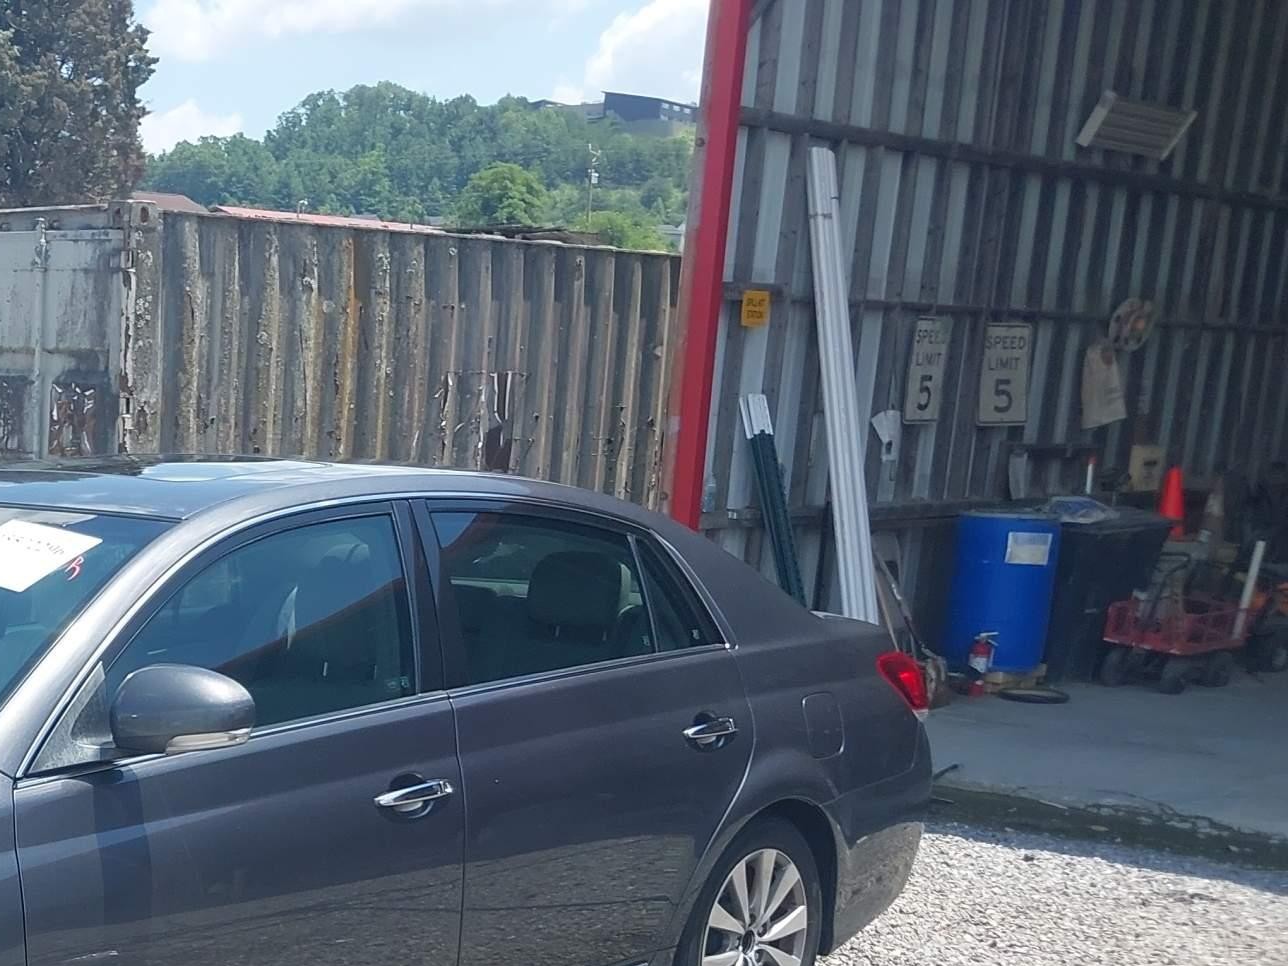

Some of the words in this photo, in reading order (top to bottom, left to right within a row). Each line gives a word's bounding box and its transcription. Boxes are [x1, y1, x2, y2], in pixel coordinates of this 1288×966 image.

[985, 335, 1026, 350] SPEED
[915, 351, 942, 367] LIMIT
[988, 356, 1021, 371] LIMIT
[917, 374, 932, 411] 5
[993, 378, 1013, 413] 5
